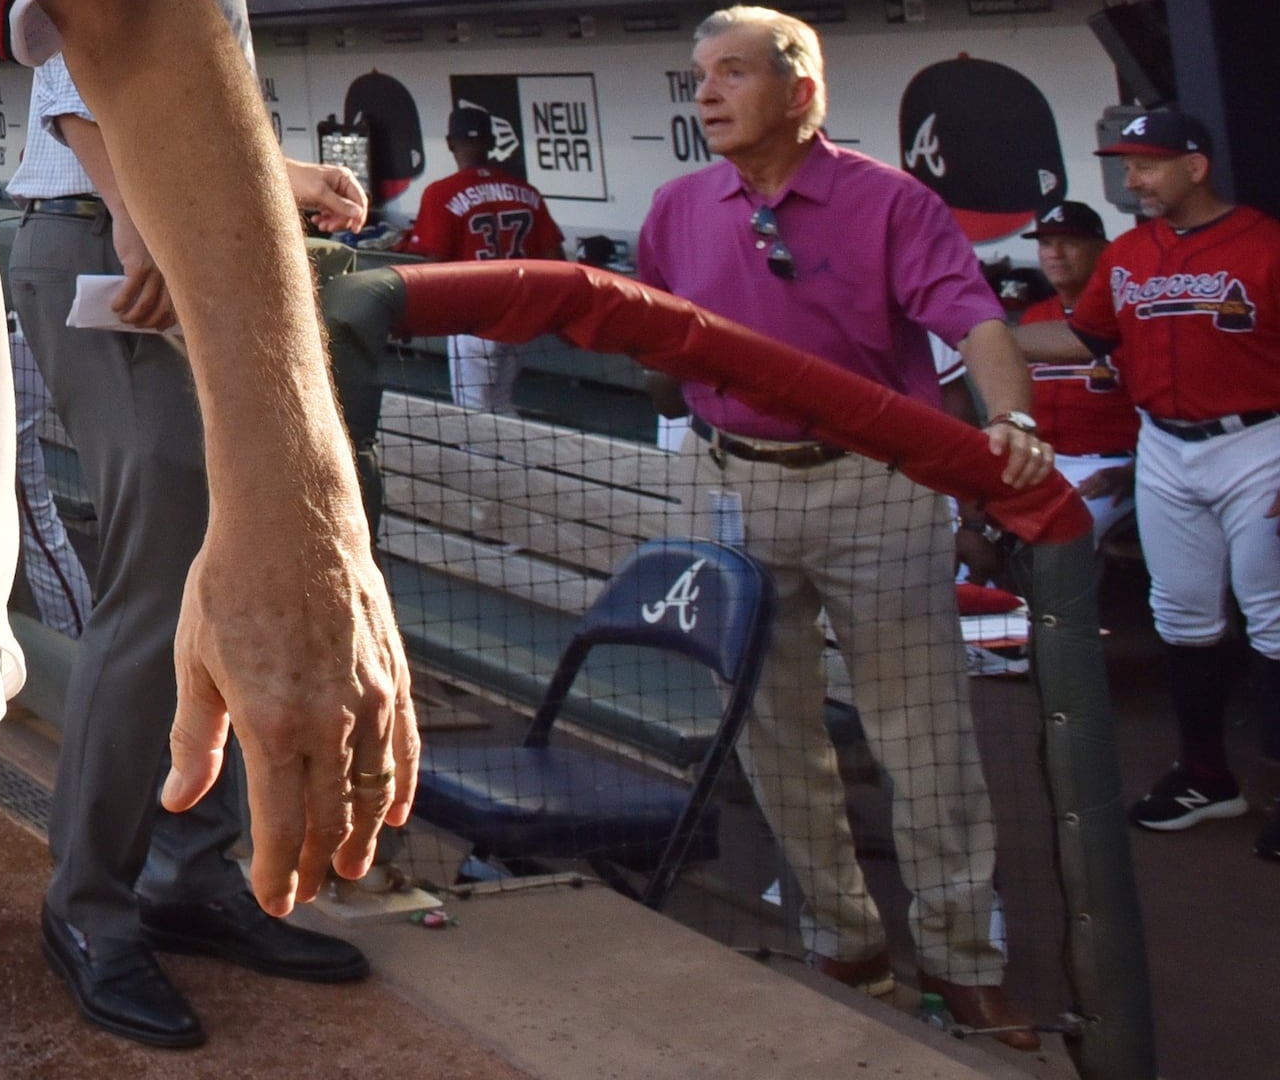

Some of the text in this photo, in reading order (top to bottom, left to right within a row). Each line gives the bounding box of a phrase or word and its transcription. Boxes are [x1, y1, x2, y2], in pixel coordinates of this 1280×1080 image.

[665, 71, 698, 103] TH
[533, 102, 588, 135] NEW
[537, 139, 593, 172] ERA
[905, 113, 945, 178] A
[445, 182, 540, 217] WASHINGTON
[469, 208, 533, 261] 37
[641, 557, 706, 634] A
